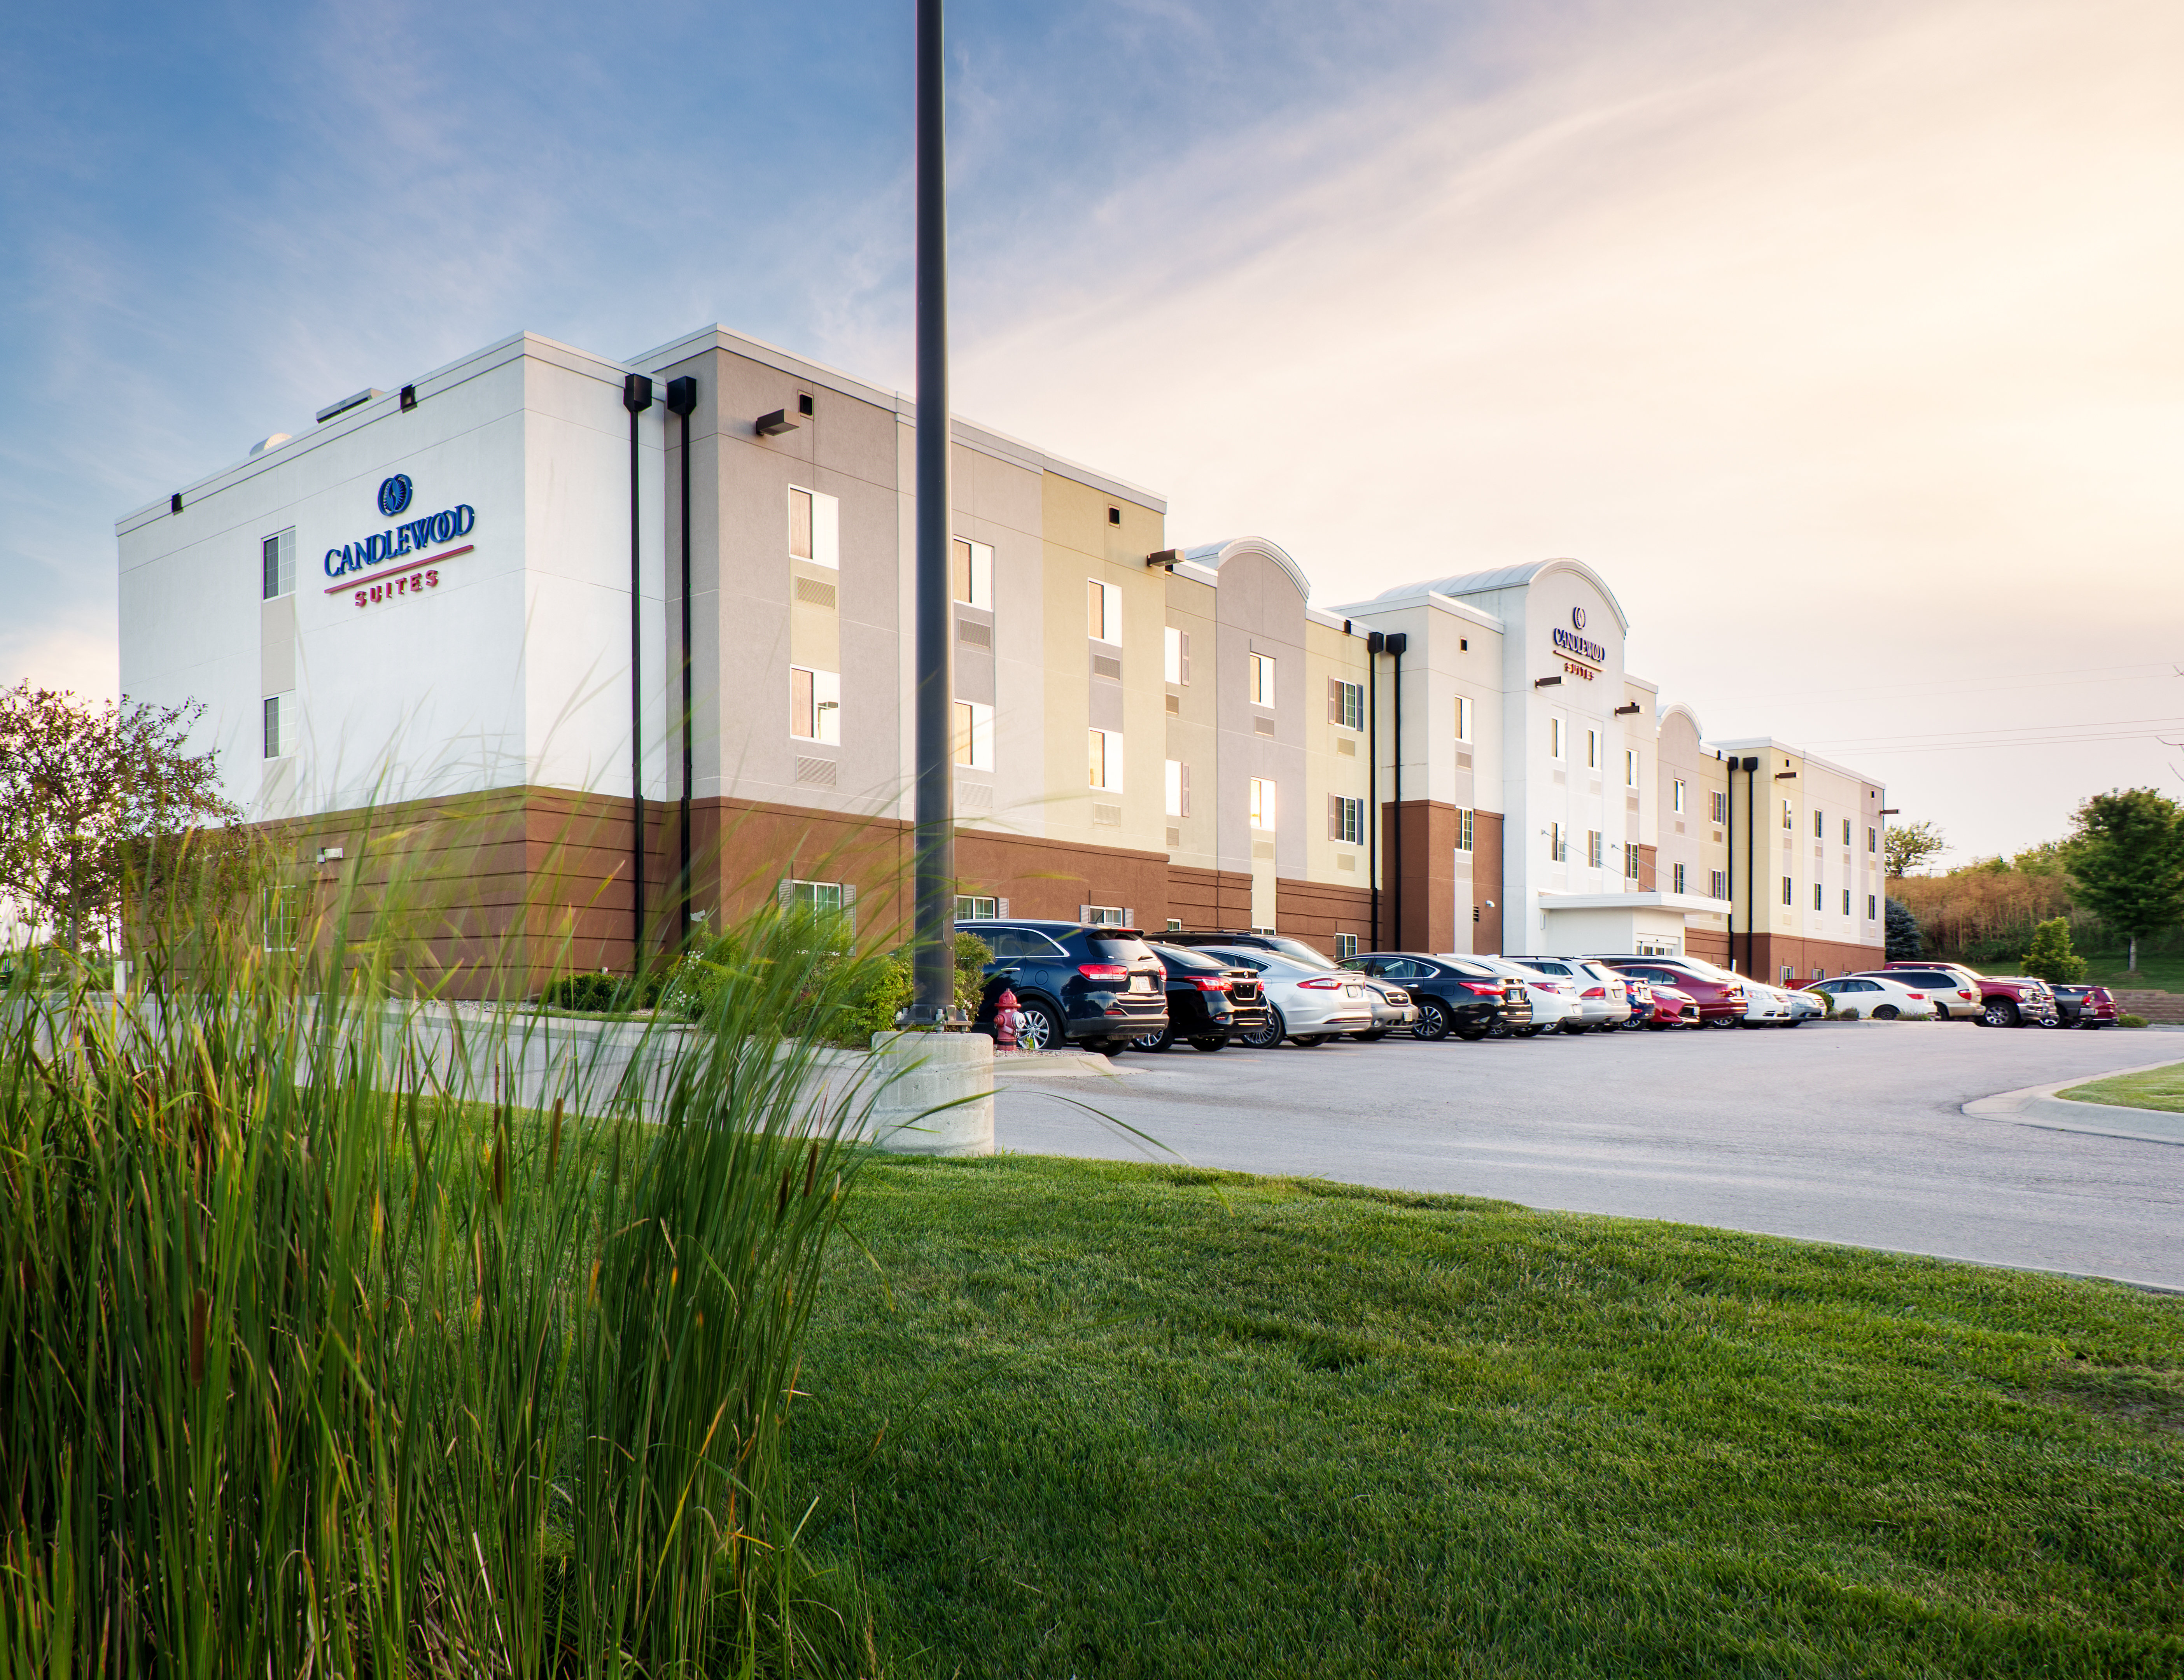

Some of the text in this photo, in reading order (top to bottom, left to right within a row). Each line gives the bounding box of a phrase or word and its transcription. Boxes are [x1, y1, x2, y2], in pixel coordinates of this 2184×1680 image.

[324, 504, 475, 577] CANDLEWOOD
[355, 570, 438, 607] SUITES
[1554, 628, 1605, 662] CANDLEWOOD
[1565, 662, 1594, 680] SUITES
